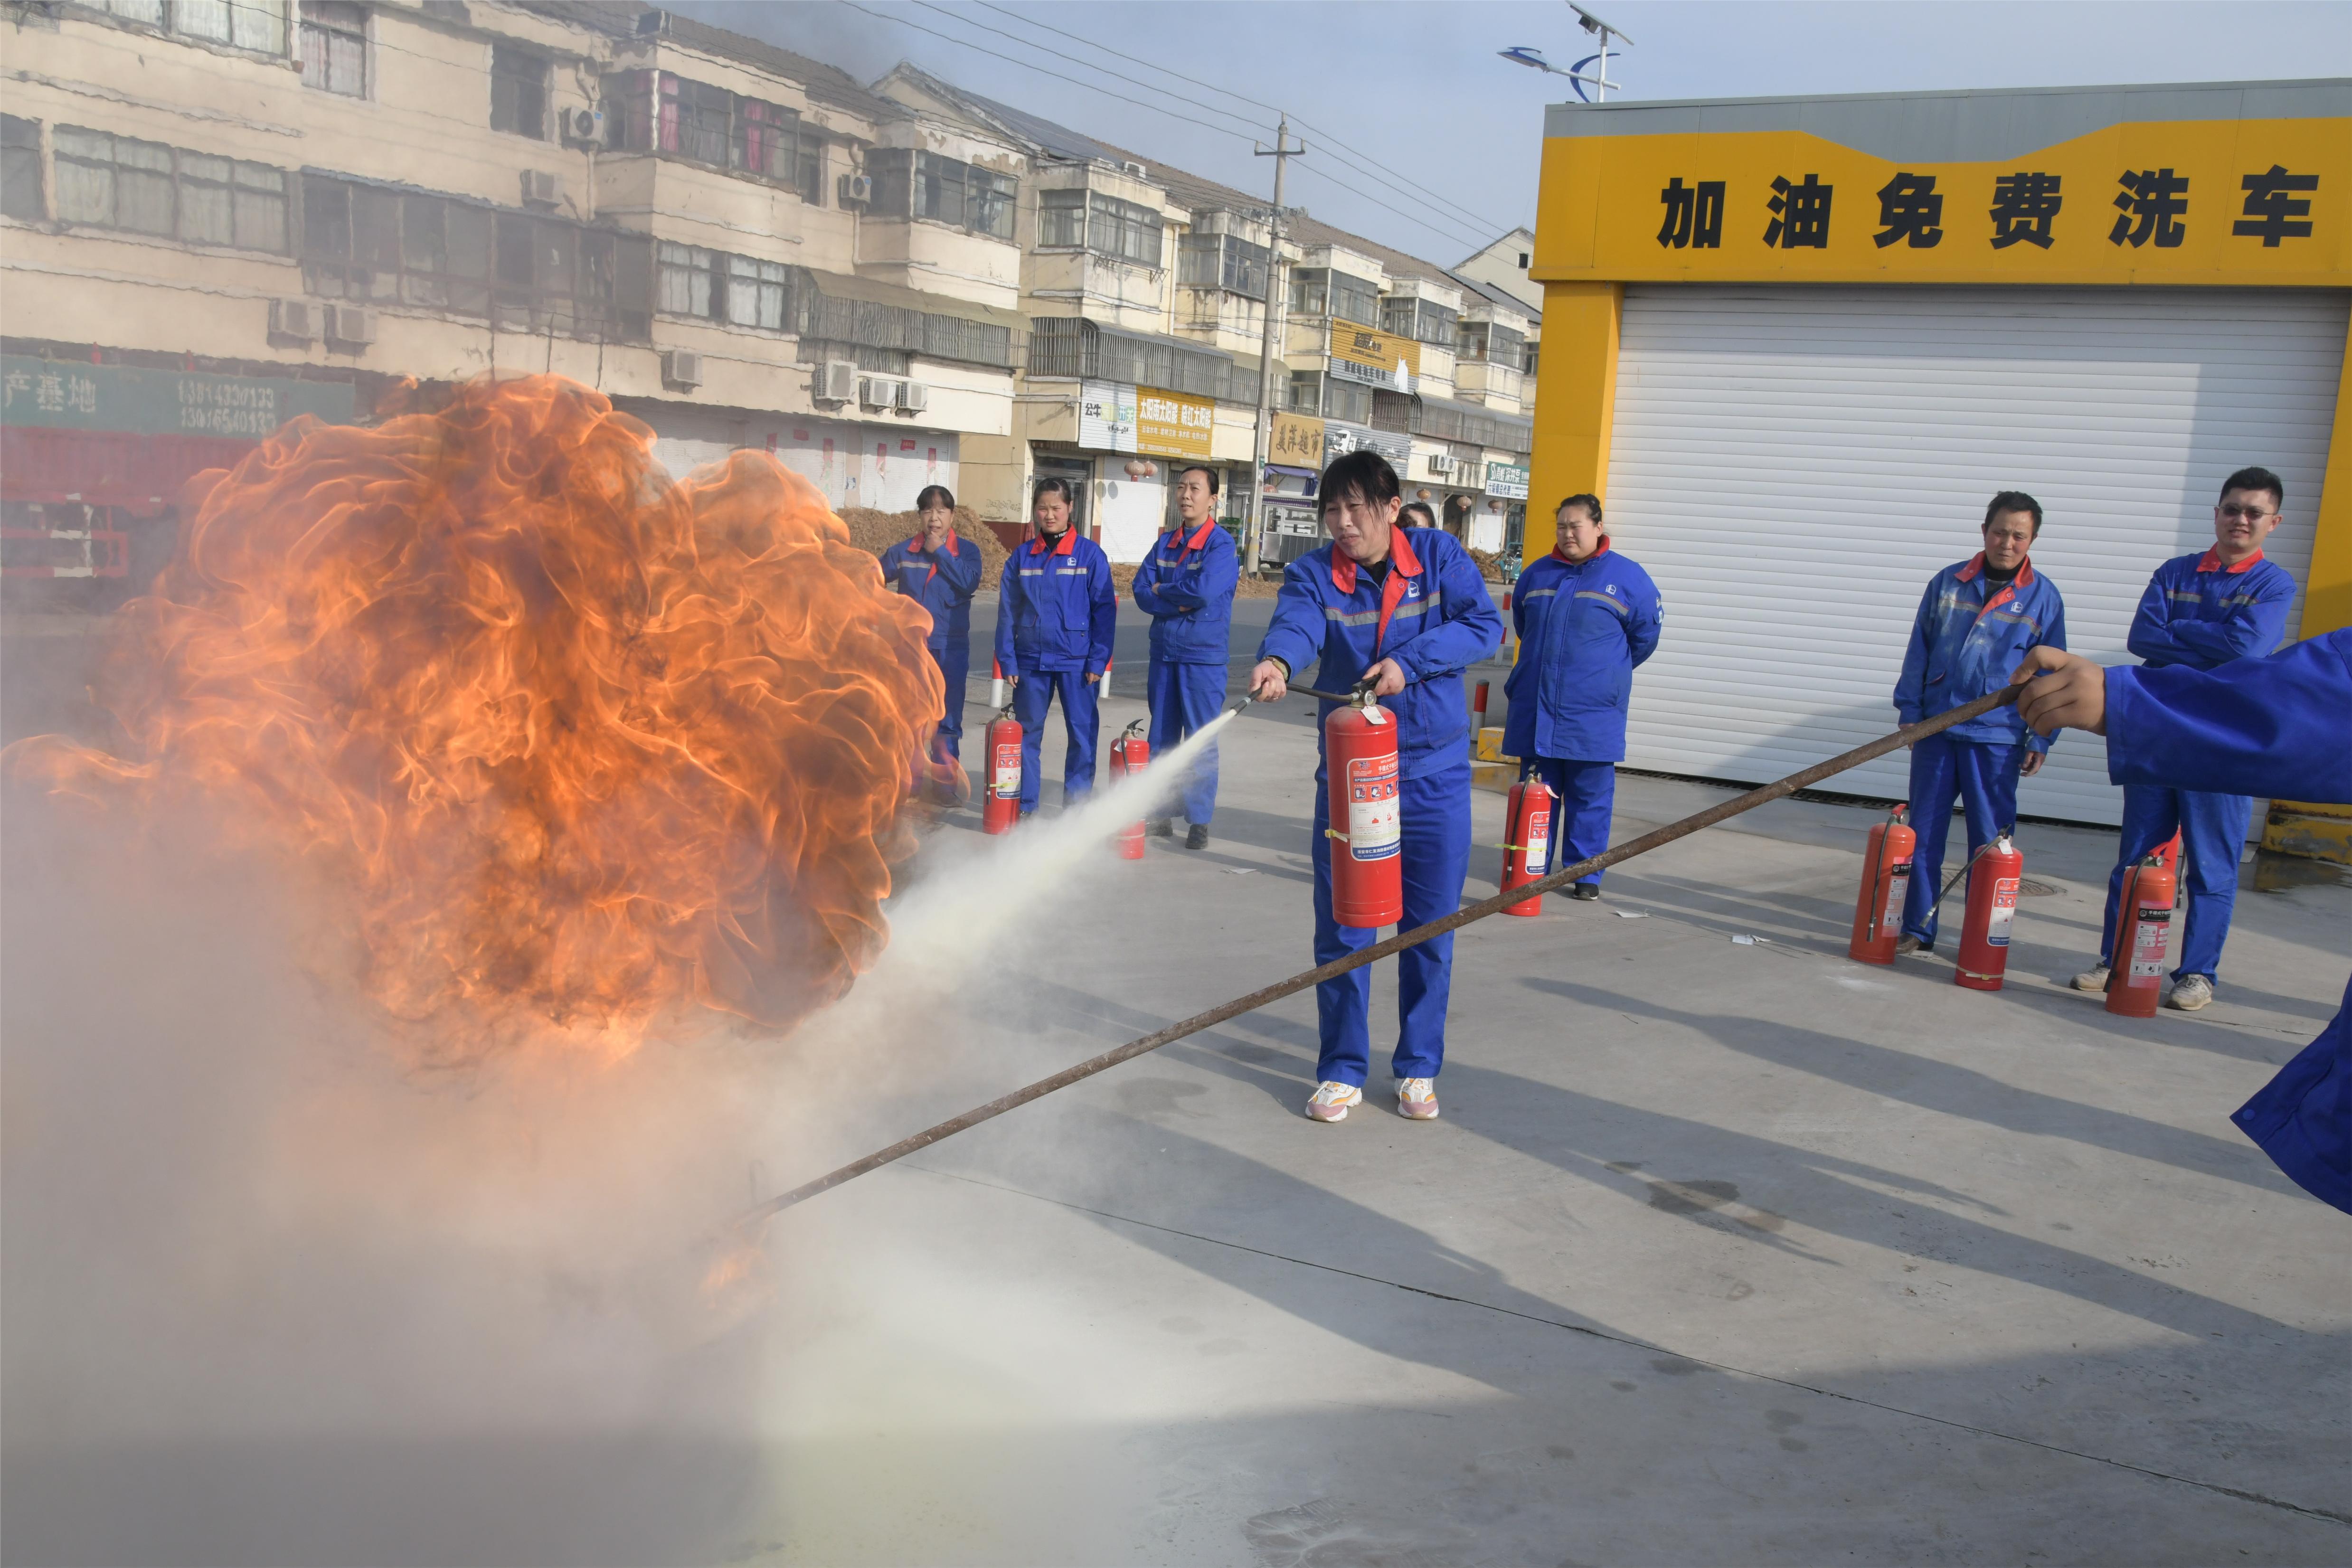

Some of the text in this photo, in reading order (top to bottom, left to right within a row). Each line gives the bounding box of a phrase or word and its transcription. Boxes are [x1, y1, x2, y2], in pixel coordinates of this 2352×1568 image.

[1656, 164, 2320, 250] 加油免费洗车
[1085, 403, 1134, 423] 公牛开关
[1140, 398, 1211, 429] 太阳雨太阳能 晓红太阳能
